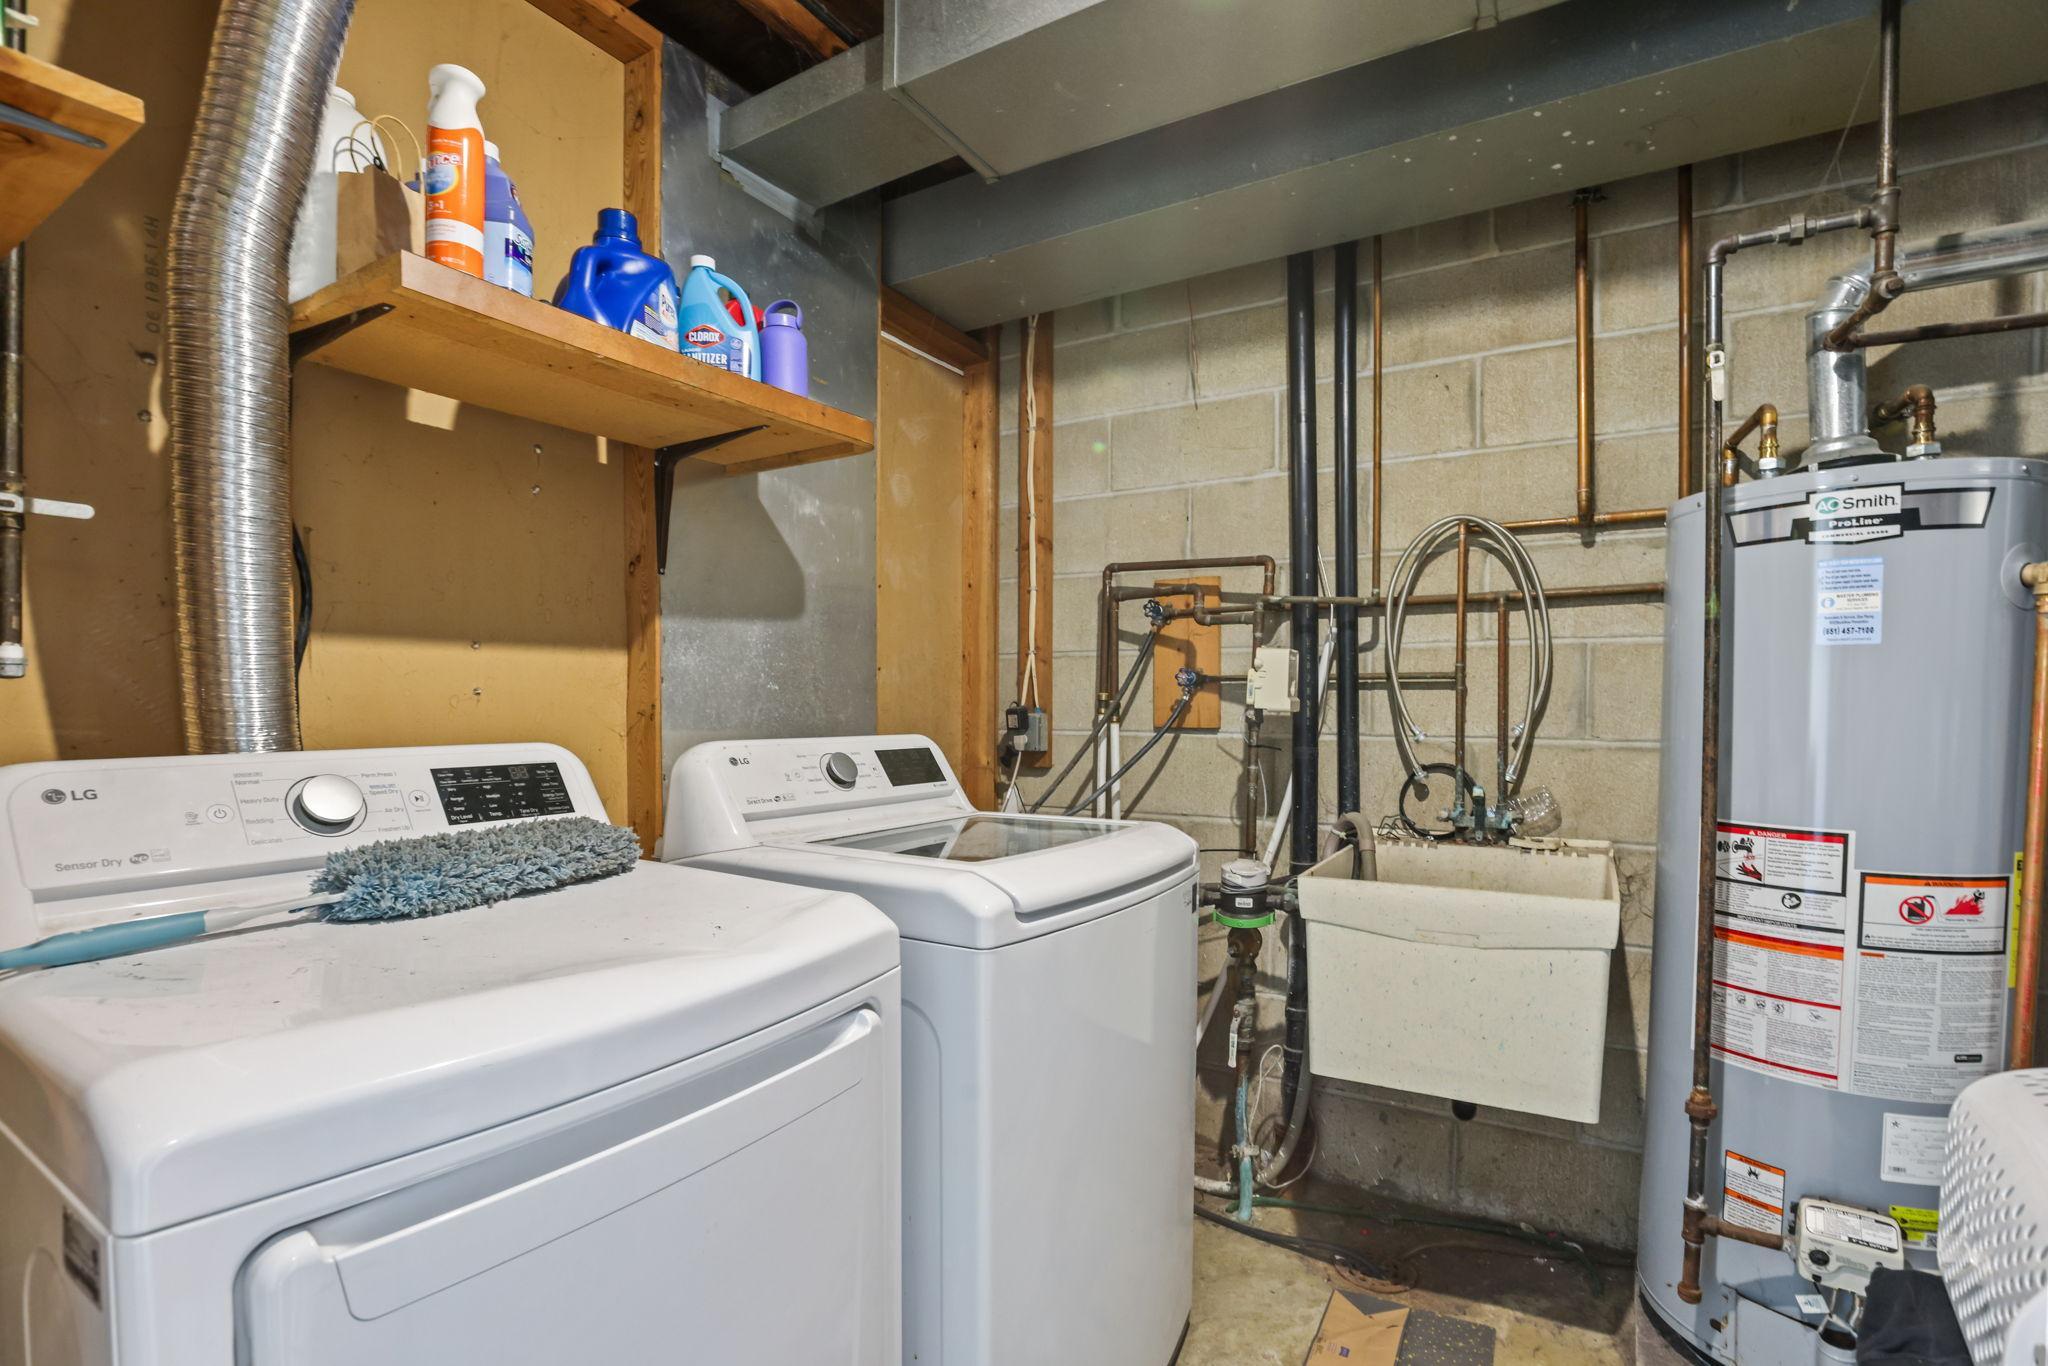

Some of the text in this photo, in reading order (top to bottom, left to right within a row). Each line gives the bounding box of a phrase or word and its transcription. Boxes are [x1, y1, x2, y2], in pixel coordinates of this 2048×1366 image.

[688, 331, 720, 343] CLOROX
[1842, 494, 1895, 509] Smith
[1828, 517, 1880, 528] ProLine
[70, 789, 98, 801] LG
[1757, 830, 1788, 839] DANGER
[55, 858, 122, 872] Sensor Dry
